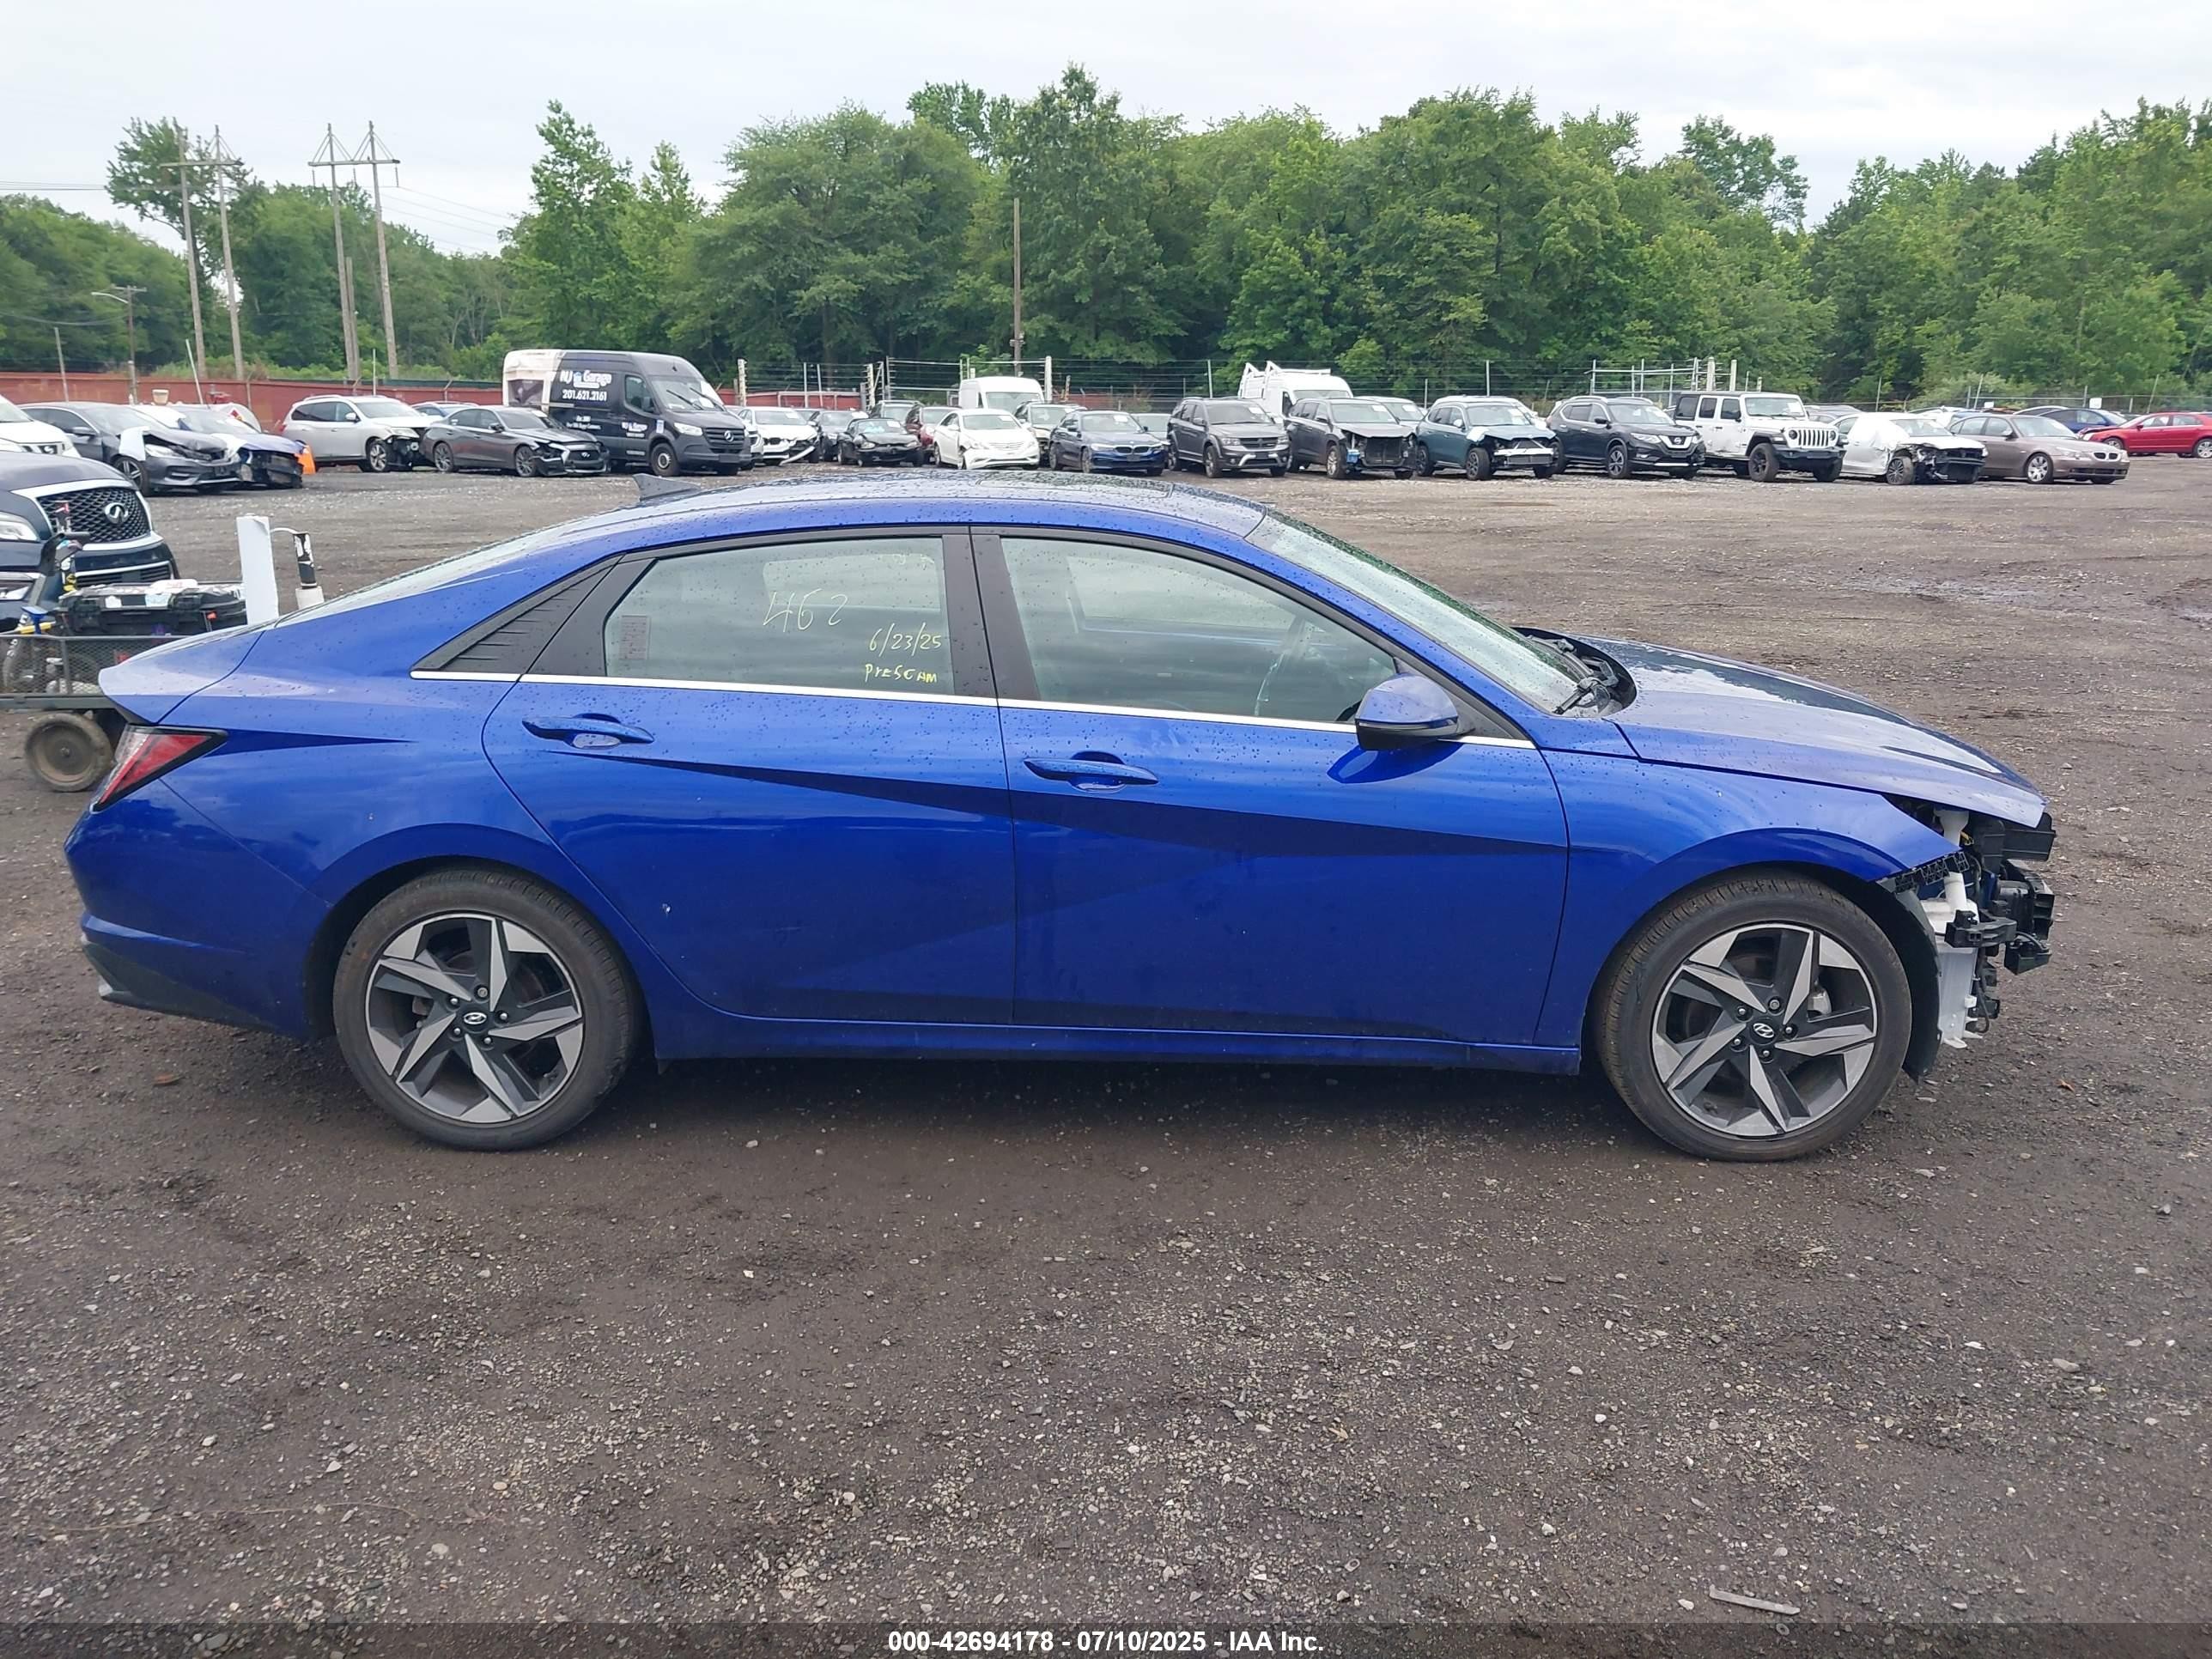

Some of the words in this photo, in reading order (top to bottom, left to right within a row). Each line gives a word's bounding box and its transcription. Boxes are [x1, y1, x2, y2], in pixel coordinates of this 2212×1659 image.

[560, 370, 573, 384] NJ
[583, 369, 612, 386] Garage
[562, 389, 607, 401] 201.621.2161
[763, 587, 848, 633] 462
[869, 622, 943, 658] 6/23/25
